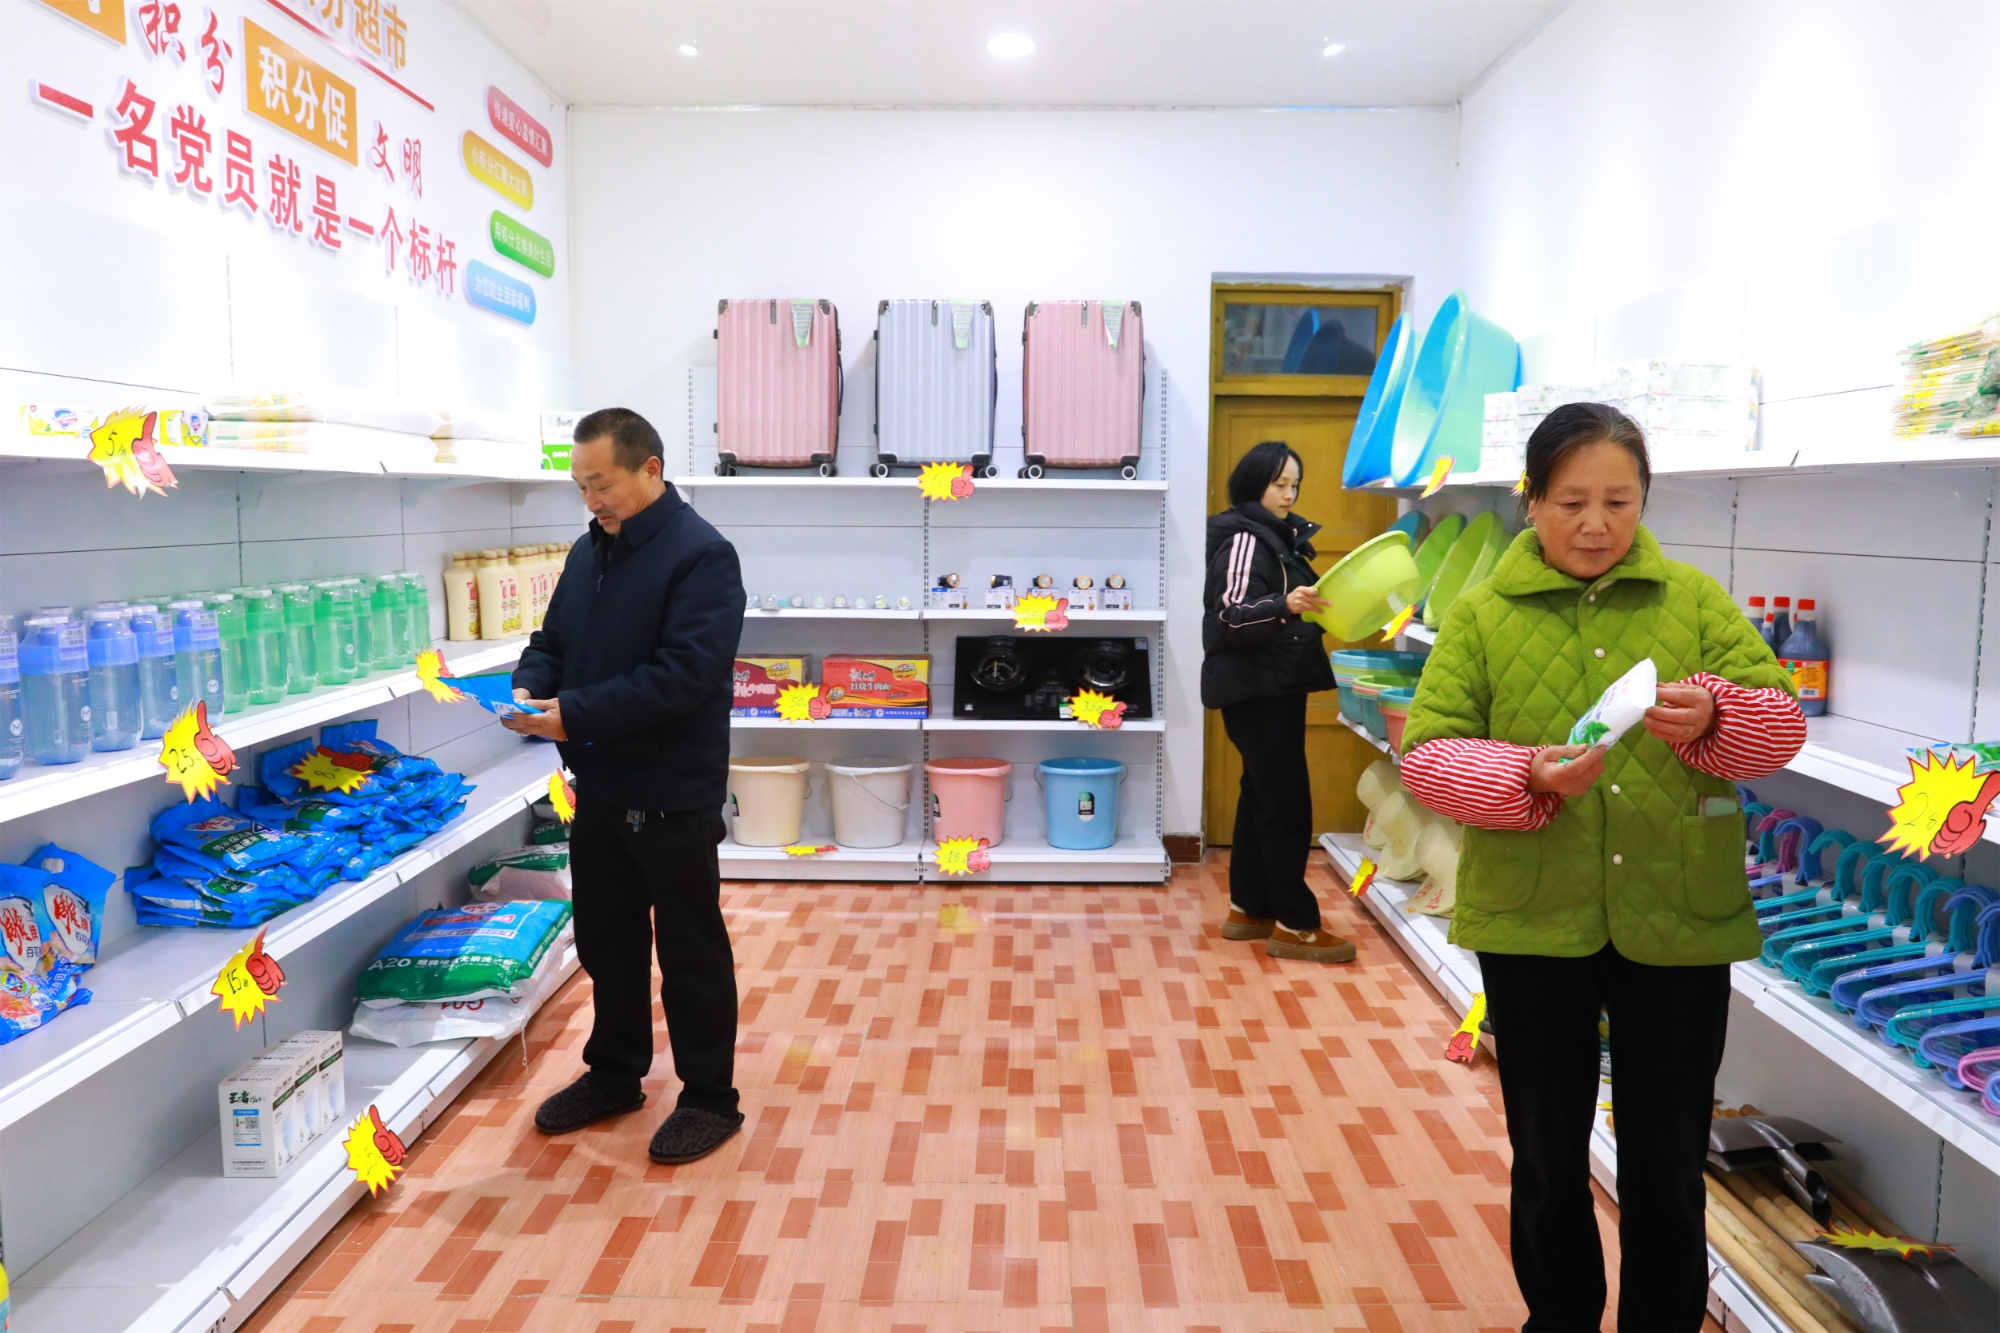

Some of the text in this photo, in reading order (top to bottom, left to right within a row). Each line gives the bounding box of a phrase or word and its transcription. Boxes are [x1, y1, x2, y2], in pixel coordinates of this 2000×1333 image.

[39, 79, 457, 293] 一名党员就是一个标杆
[258, 45, 348, 149] 积分促
[371, 120, 421, 199] 文明
[851, 682, 891, 691] 红烧牛肉面
